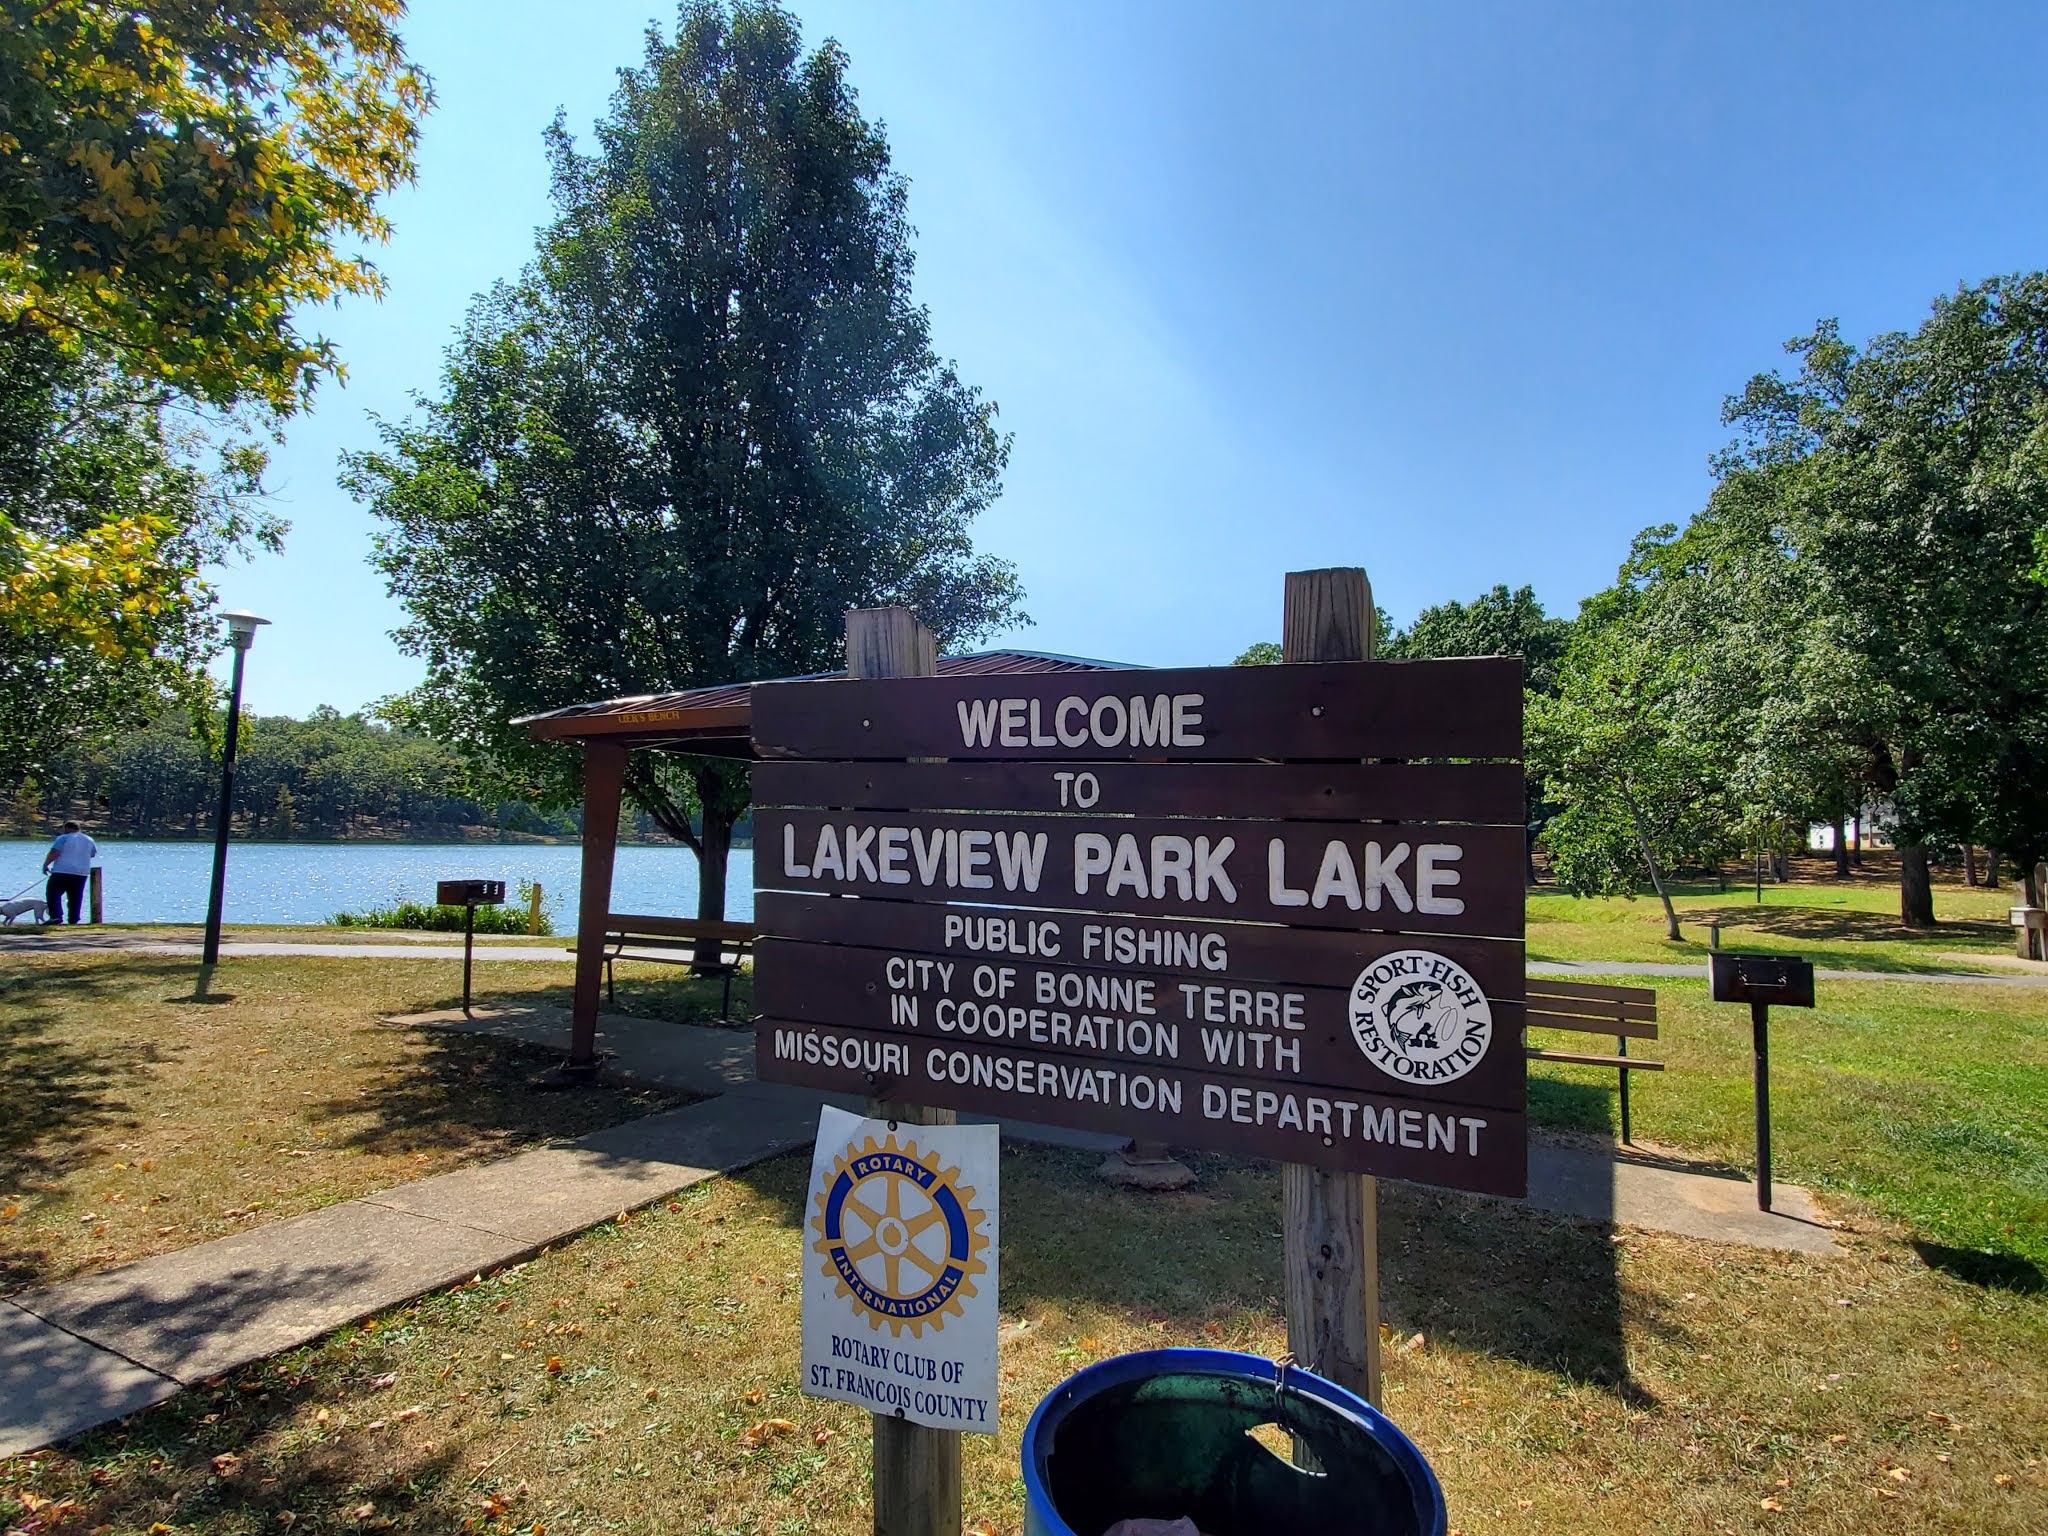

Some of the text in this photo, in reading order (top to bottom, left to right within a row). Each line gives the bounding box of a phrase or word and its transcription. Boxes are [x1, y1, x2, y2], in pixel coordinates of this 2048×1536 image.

[648, 711, 680, 721] BENCH
[957, 693, 1206, 748] WELCOME
[1053, 772, 1100, 809] TO
[783, 823, 1465, 915] LAKEVIEW PARK LAKE
[945, 914, 1228, 971] PUBLIC FISHING
[886, 956, 1306, 1030] CITY OF BONNE TERRE
[1357, 956, 1481, 1010] SPORT FISH
[891, 993, 1300, 1073] IN COOPERATION WITH
[1355, 1011, 1487, 1080] RESTORATION
[775, 1029, 1487, 1156] MISSOURI CONSERVATION DEPARTMENT
[858, 1156, 928, 1182] ROTARY
[836, 1255, 957, 1315] INTERNATIONAL
[832, 1335, 965, 1384] ROTARY CLUB OF
[811, 1363, 988, 1422] ST. FRANCOIS COUNTY
